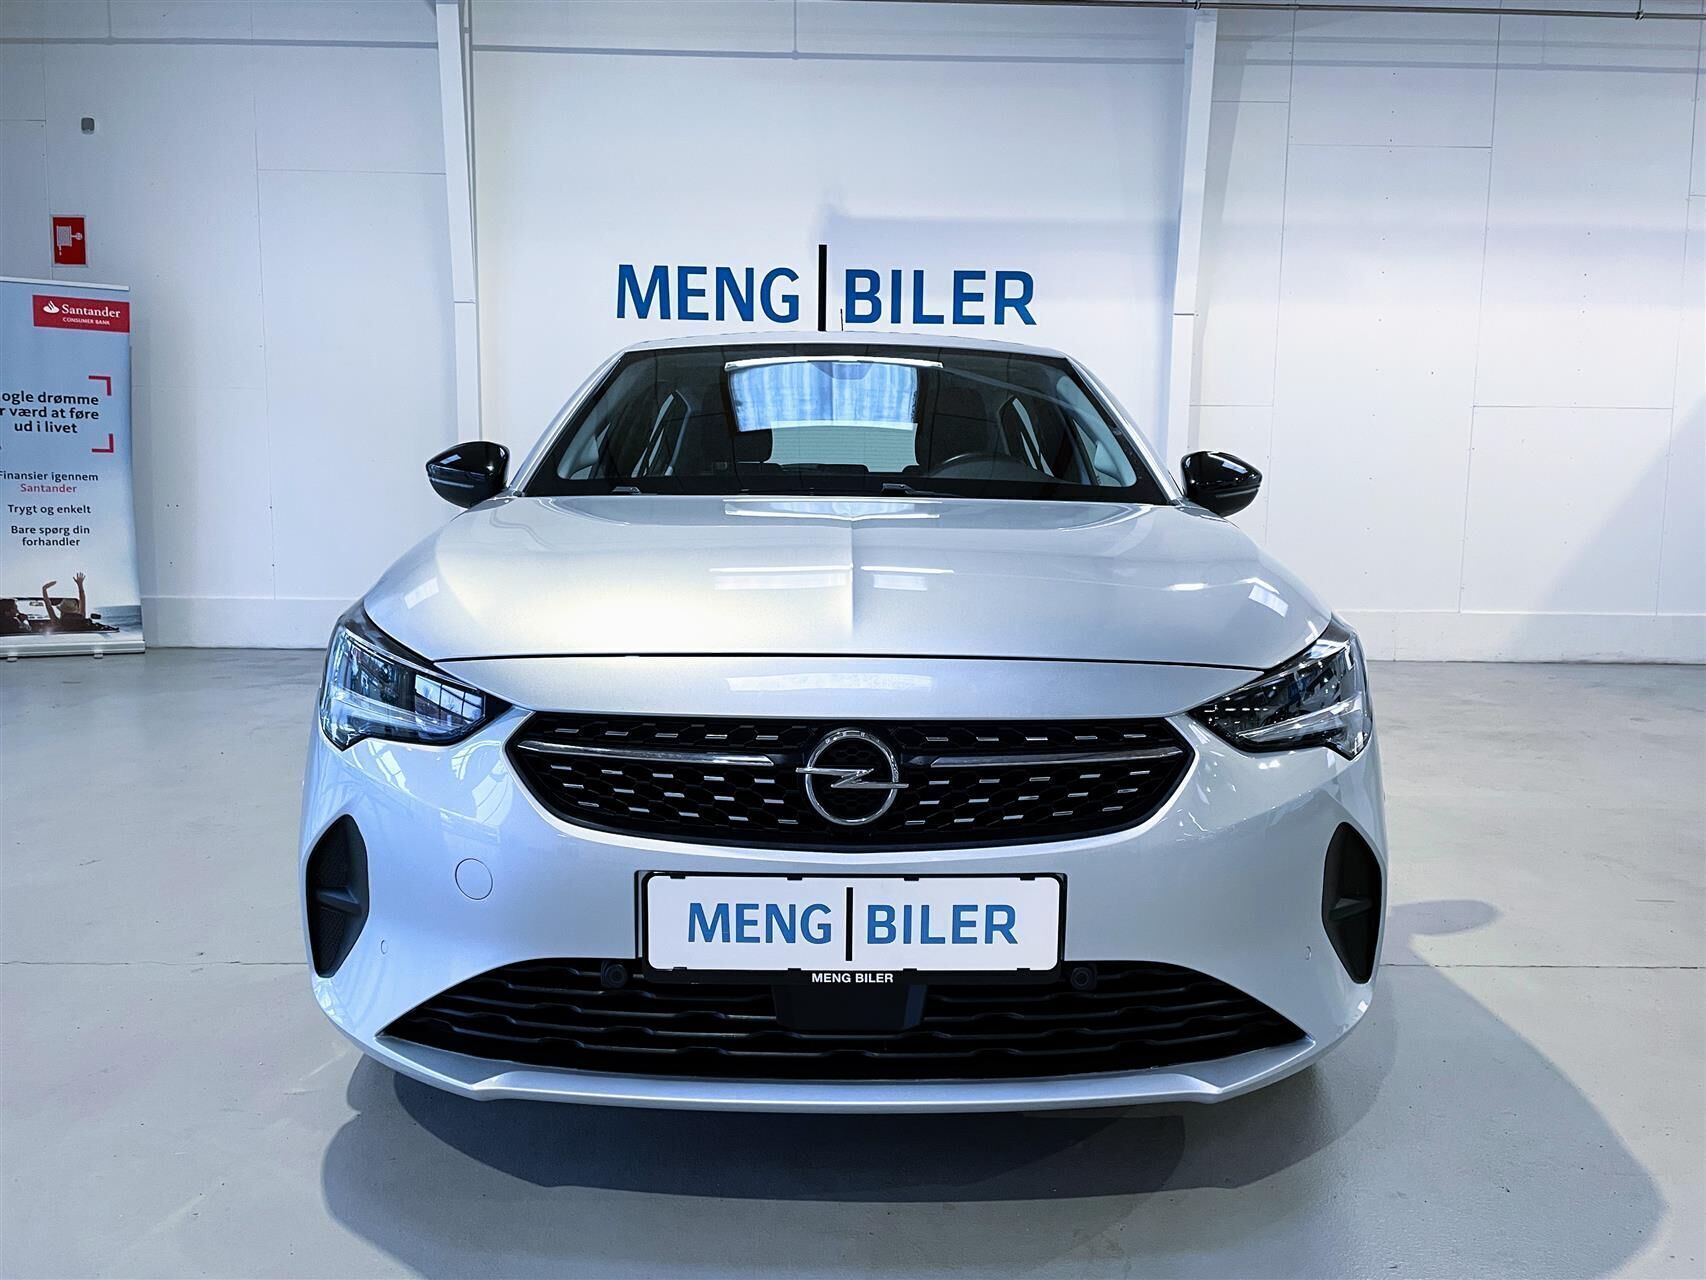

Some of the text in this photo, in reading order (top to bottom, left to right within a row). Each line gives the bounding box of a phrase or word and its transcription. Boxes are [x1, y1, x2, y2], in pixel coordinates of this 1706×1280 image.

[616, 263, 1037, 325] MENG BILER
[61, 304, 121, 318] Santander
[2, 390, 99, 405] ogle drømme
[9, 406, 47, 418] værd
[51, 409, 66, 418] at
[69, 408, 99, 420] føre
[14, 420, 78, 433] ud i livet
[51, 471, 99, 482] igennem
[20, 483, 77, 493] Santander
[7, 504, 91, 516] Trygt og enkelt
[11, 525, 90, 536] Bare spørg din
[22, 537, 80, 547] forhandler
[687, 902, 1019, 945] MENG BILER
[811, 972, 894, 984] MENG BILER
